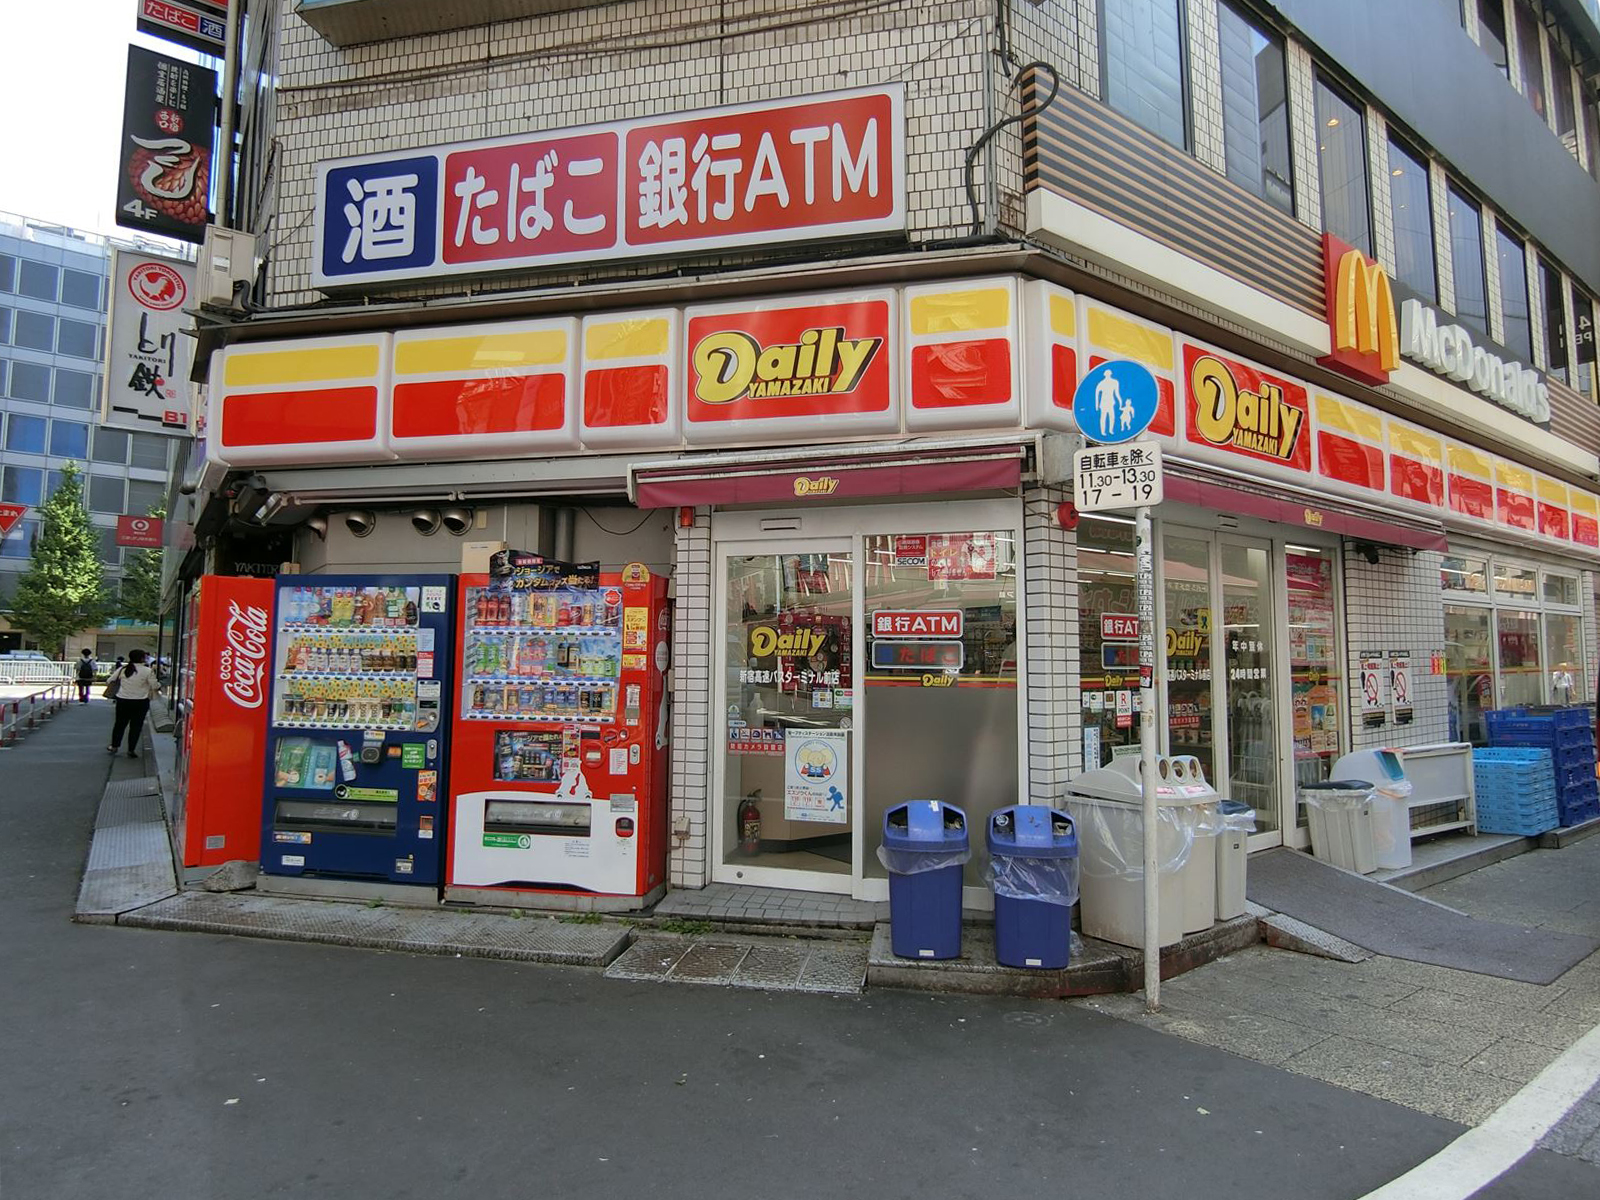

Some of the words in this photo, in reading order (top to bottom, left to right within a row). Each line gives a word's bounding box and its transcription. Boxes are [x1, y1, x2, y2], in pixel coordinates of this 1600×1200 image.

[143, 0, 197, 29] たばこ
[201, 20, 224, 39] 酒
[636, 116, 880, 230] 銀行ATM
[123, 199, 158, 220] 4F
[453, 148, 606, 249] たばこ
[341, 173, 419, 264] 酒
[129, 354, 166, 364] YAKITORI
[695, 327, 884, 404] Daily
[128, 362, 165, 400] 鉄
[748, 378, 829, 398] YAMAZAKI
[164, 411, 187, 424] B1
[1191, 356, 1302, 460] Daily
[1231, 427, 1278, 455] YAMAZAKI
[1080, 449, 1154, 471] 自転車を除く
[794, 477, 840, 496] Daily
[897, 557, 925, 566] SECOM
[877, 616, 958, 632] 銀行ATM
[1103, 618, 1139, 635] 銀行AT
[223, 598, 268, 708] Coca-Cola
[752, 626, 827, 657] Daily
[1166, 627, 1202, 657] Daily
[922, 673, 954, 687] Daily
